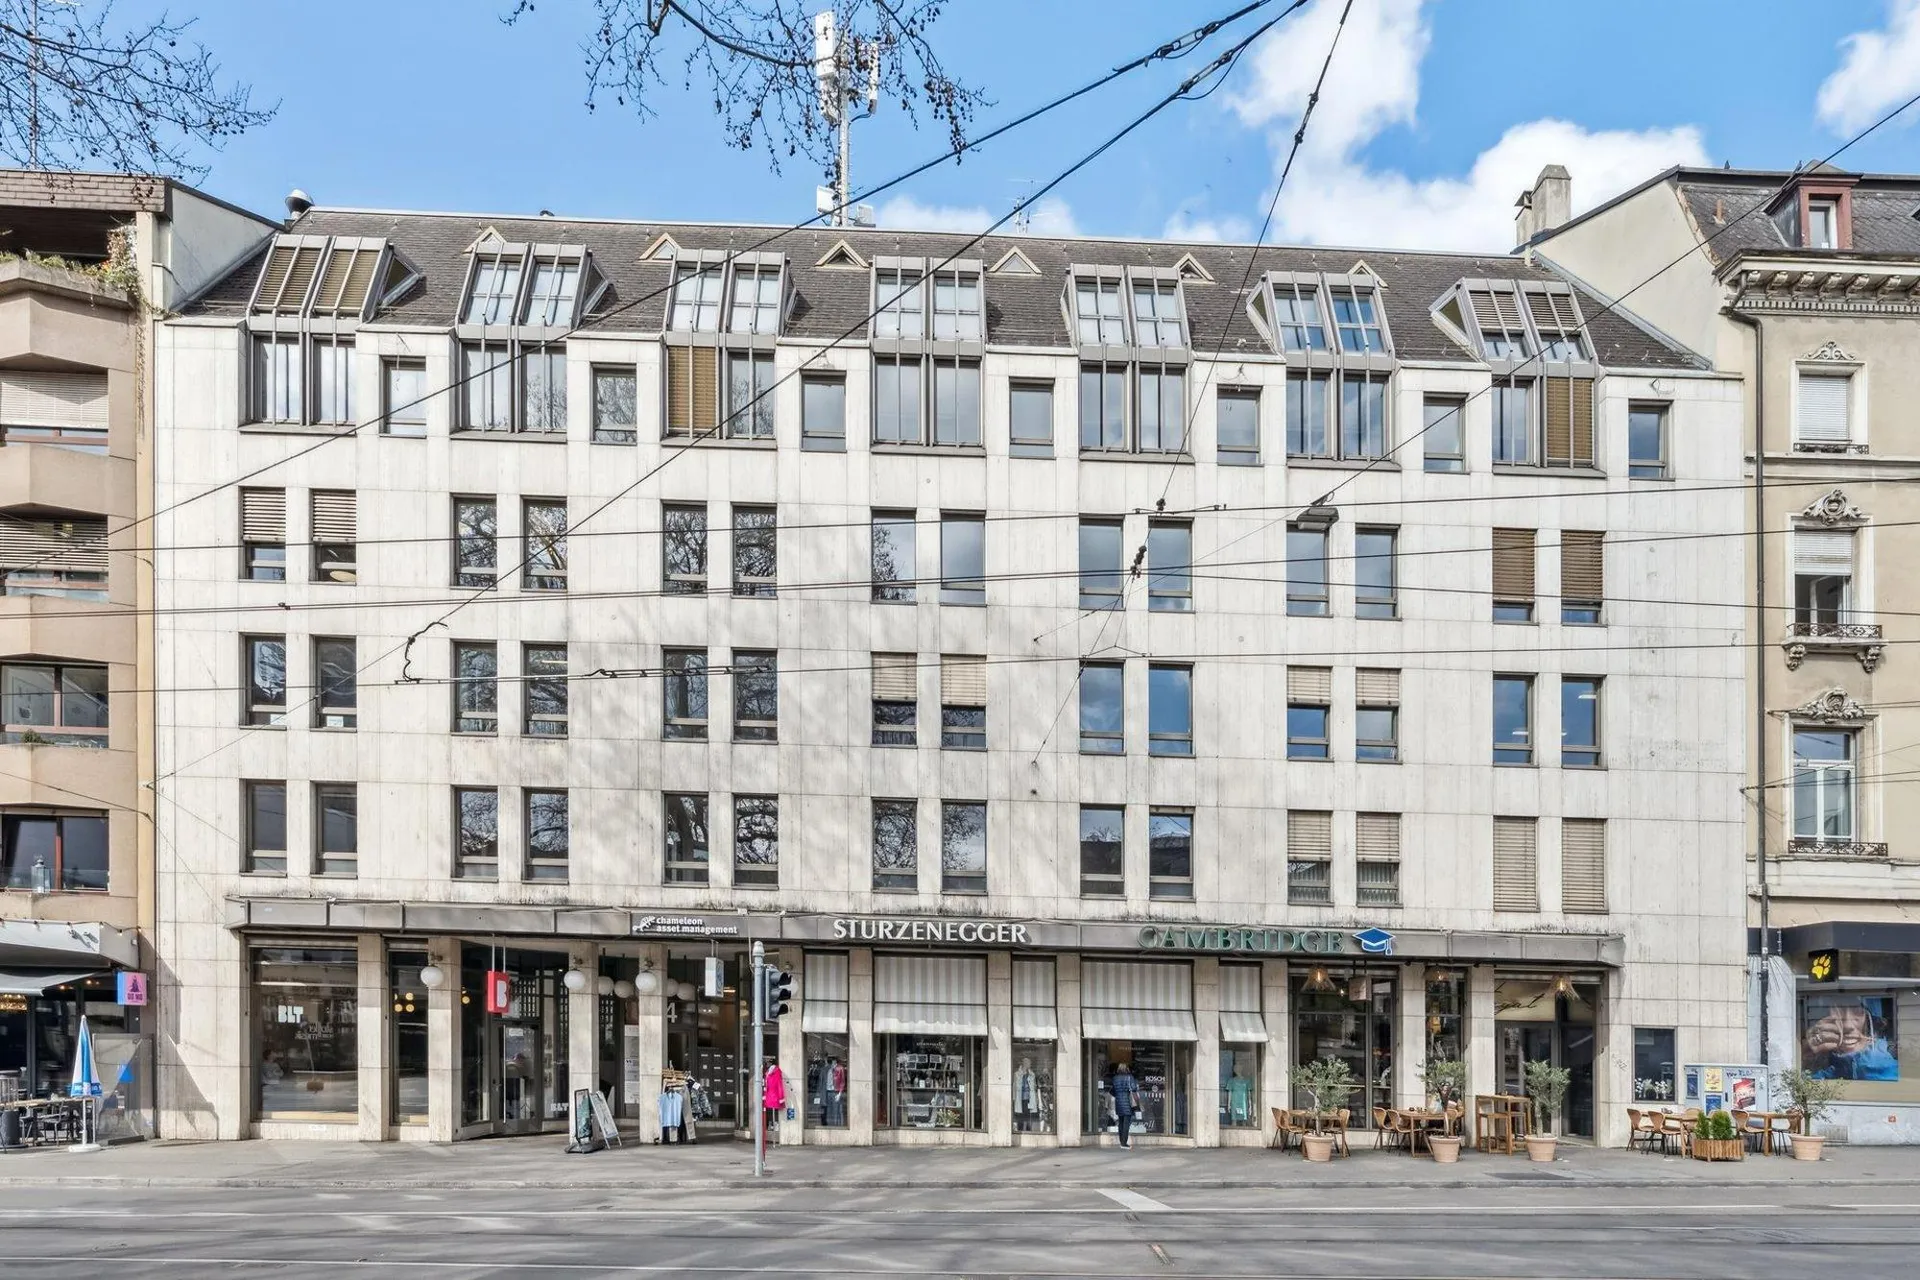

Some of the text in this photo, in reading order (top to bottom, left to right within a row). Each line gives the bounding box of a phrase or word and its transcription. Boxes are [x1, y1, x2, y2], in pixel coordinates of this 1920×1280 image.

[656, 916, 703, 925] chameleon
[656, 925, 738, 935] asset management
[833, 919, 1027, 943] STURZENEGGER
[1137, 925, 1345, 953] CAMBRIDGE
[497, 980, 508, 1008] B
[277, 1005, 304, 1024] BLT
[666, 1002, 678, 1024] 4
